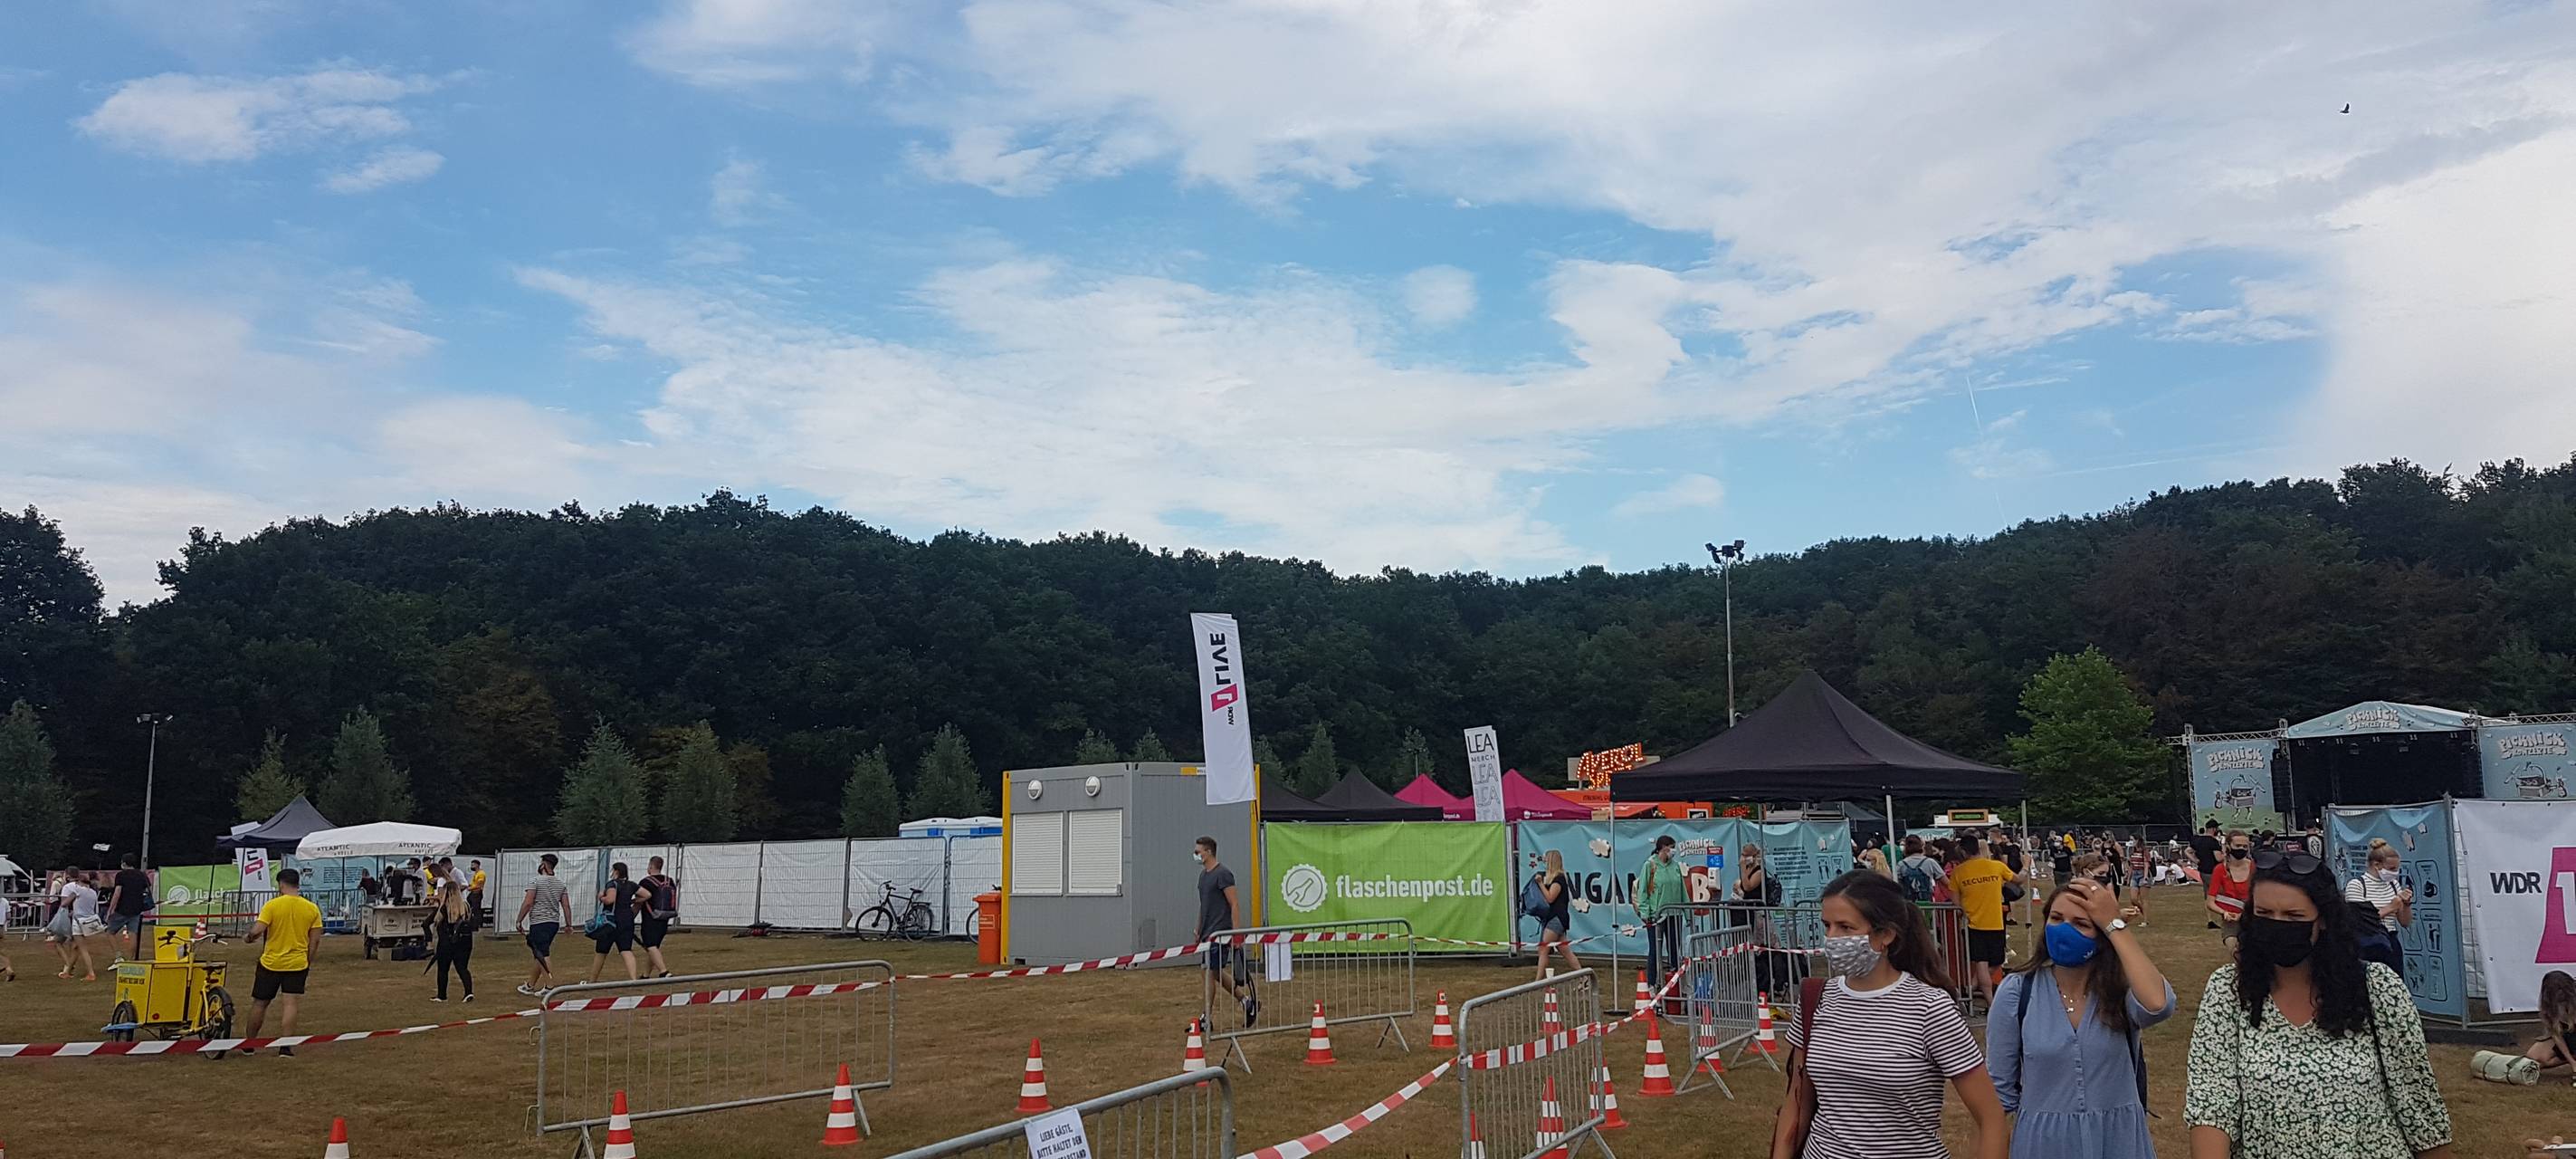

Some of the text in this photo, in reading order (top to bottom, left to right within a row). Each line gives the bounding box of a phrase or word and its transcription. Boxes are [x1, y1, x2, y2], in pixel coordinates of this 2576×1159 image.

[1466, 733, 1495, 753] LEA
[1471, 754, 1495, 762] MERCH
[1577, 742, 1644, 780] APEROL
[1473, 763, 1499, 785] LEA
[1475, 786, 1501, 808] LEA
[1336, 874, 1493, 903] flaschenpost.de
[1691, 873, 1711, 903] B
[1961, 876, 1999, 886] SECURITY
[2489, 872, 2543, 895] WDR
[1039, 1129, 1054, 1142] LIEBE
[1036, 1135, 1083, 1159] BITTE HALTET DEN
